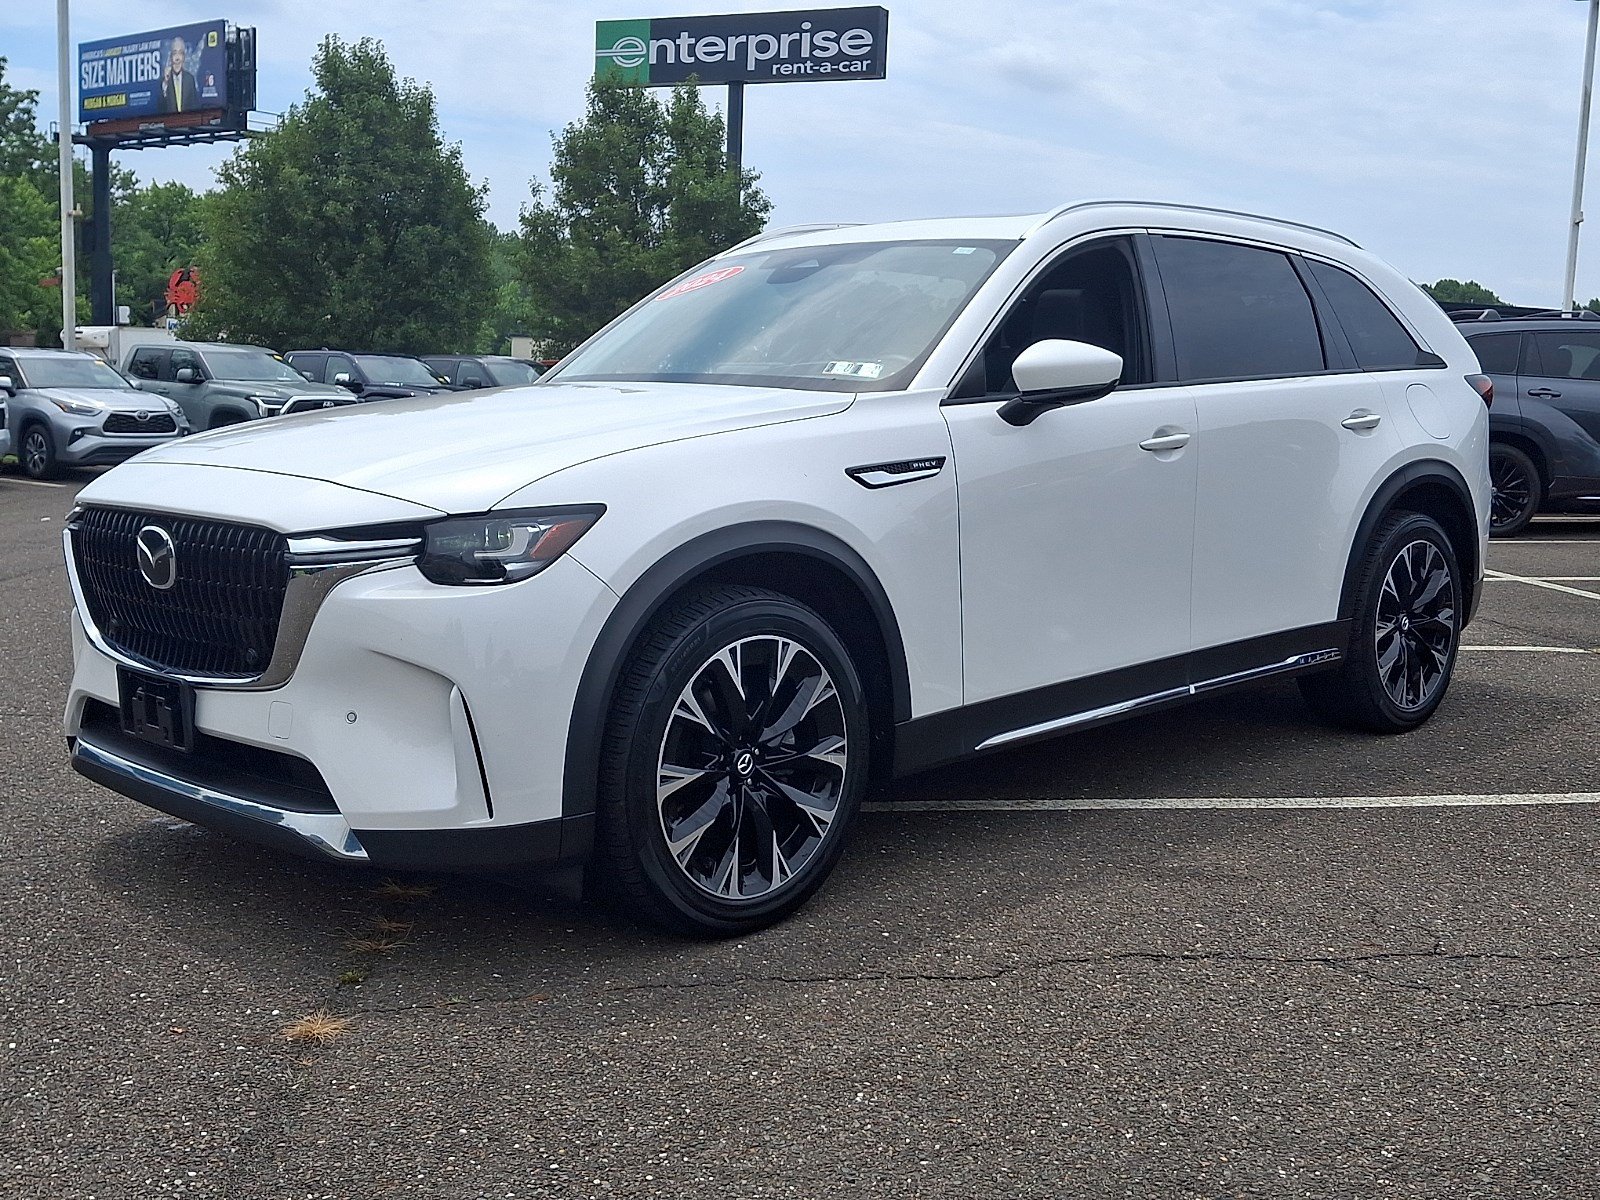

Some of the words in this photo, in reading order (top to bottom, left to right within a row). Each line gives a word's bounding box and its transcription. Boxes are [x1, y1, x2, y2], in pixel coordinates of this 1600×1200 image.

[138, 42, 148, 51] LAW
[148, 40, 161, 50] FIRM
[597, 21, 873, 71] enterprise
[82, 60, 105, 90] SIZE
[106, 51, 161, 86] MATTERS
[772, 59, 871, 75] rent-a-car
[912, 460, 937, 469] PHEV
